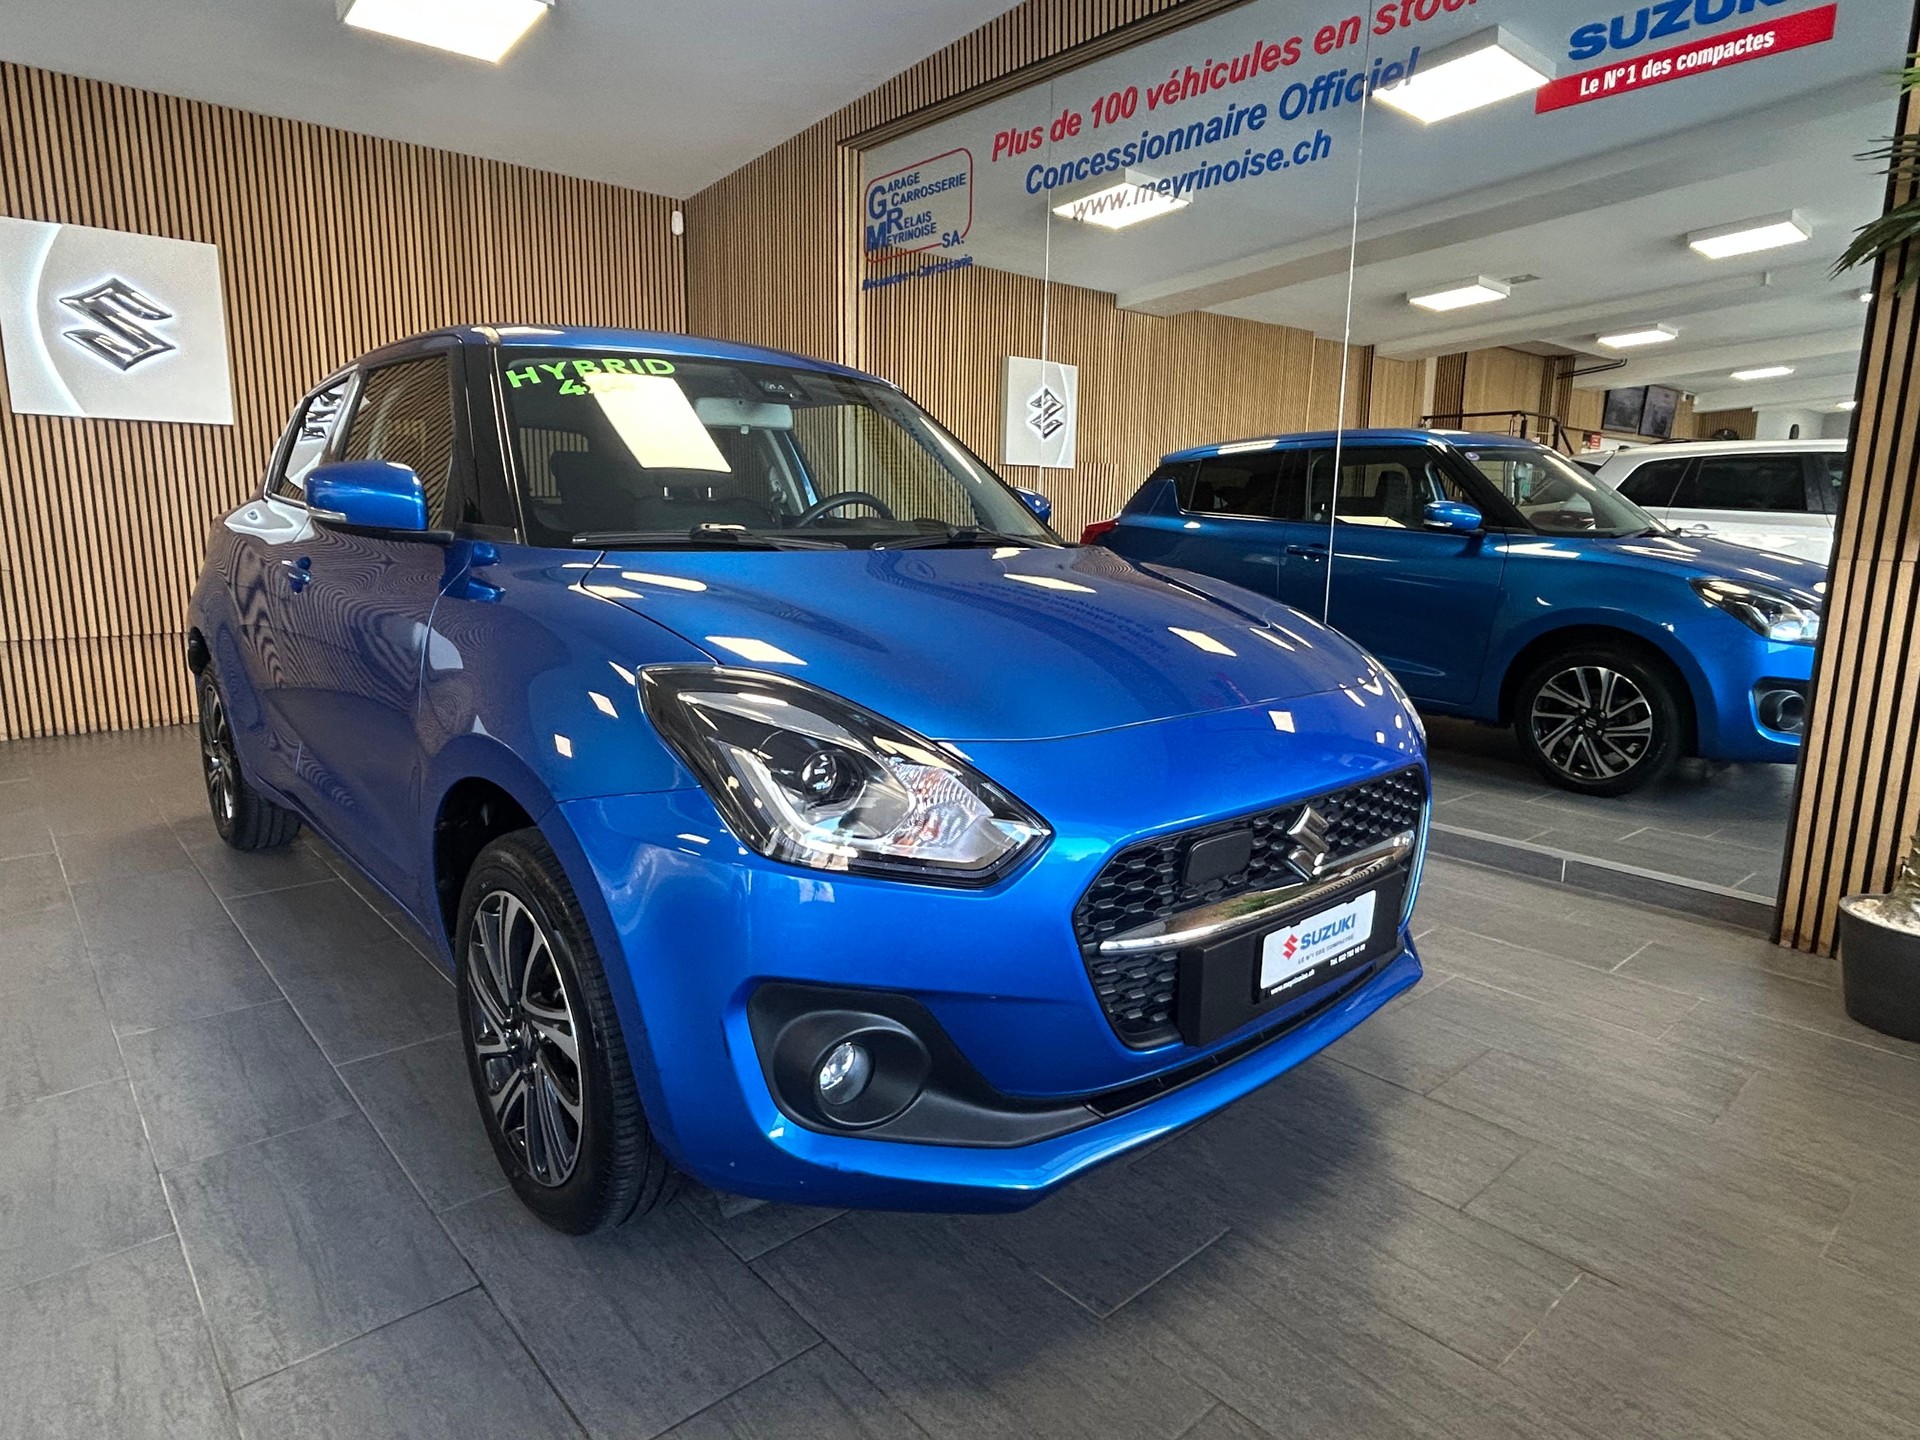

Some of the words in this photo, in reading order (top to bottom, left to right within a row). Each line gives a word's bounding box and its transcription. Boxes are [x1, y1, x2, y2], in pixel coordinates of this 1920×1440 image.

[1568, 0, 1787, 61] SUZU
[991, 124, 1043, 162] Plus
[1050, 110, 1082, 143] de
[1091, 91, 1138, 130] 100
[1147, 35, 1302, 110] véhicules
[1313, 16, 1361, 56] en
[1372, 0, 1478, 35] sto
[1580, 77, 1599, 96] Le
[1641, 59, 1672, 80] des
[1676, 31, 1776, 71] compactes
[1025, 104, 1267, 195] Concessionnaire
[1278, 46, 1420, 120] Officiel
[868, 172, 920, 220] GARAGE
[891, 173, 967, 207] CARROSSERIE
[1073, 130, 1332, 221] www.meyrinoise.ch
[866, 221, 937, 252] MEYRINOISE
[886, 207, 932, 234] RELAIS
[505, 358, 676, 388] HYBRID
[1300, 913, 1357, 950] SUZUKI
